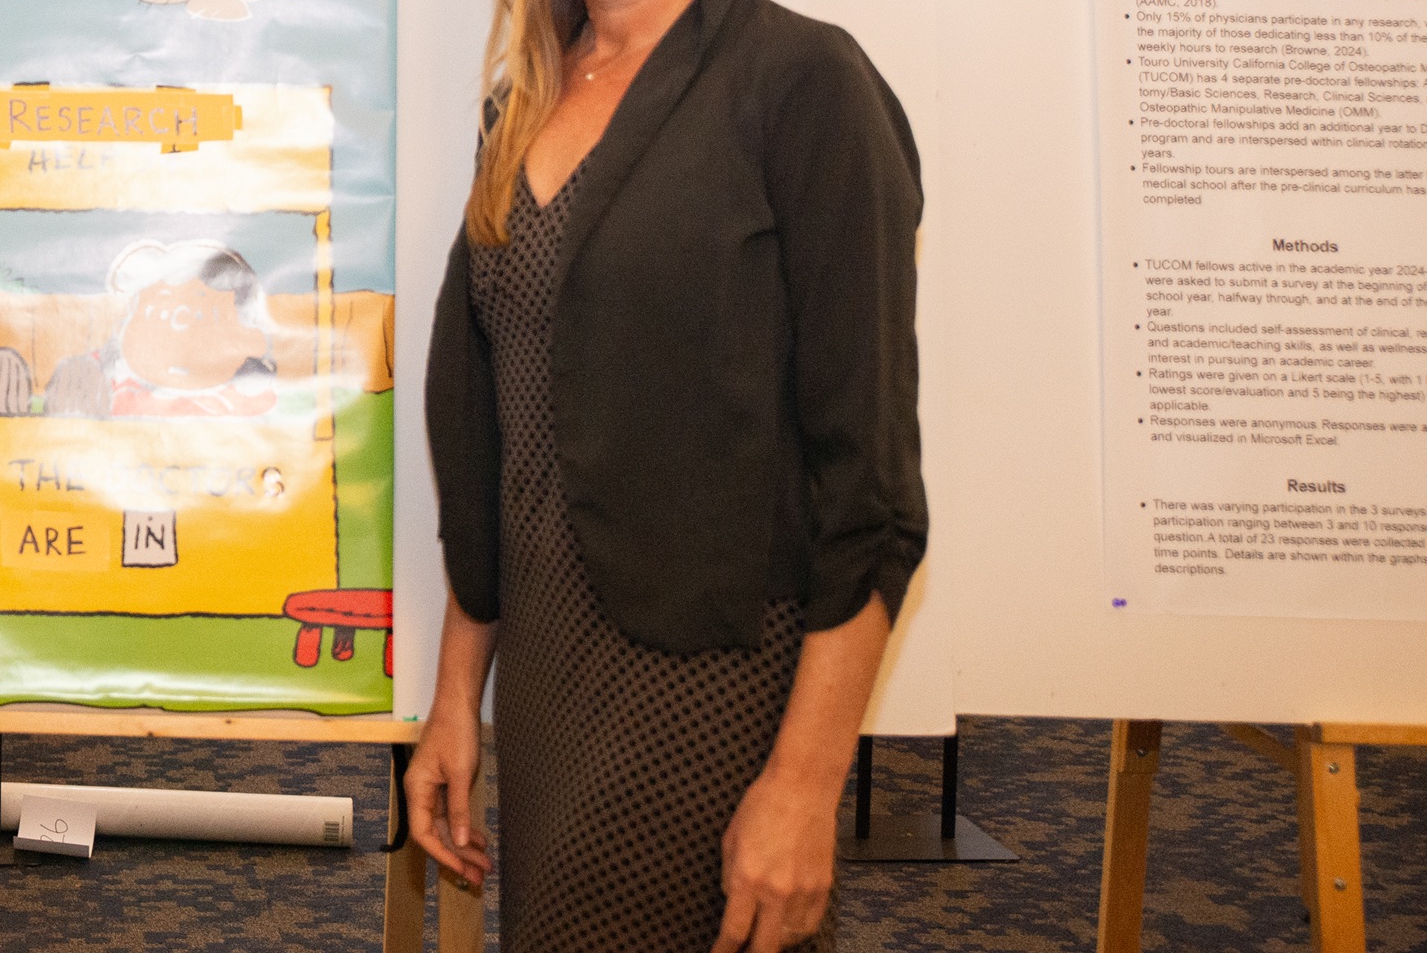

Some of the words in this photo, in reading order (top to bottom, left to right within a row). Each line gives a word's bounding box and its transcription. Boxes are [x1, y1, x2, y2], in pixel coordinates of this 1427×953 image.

[8, 98, 198, 137] RESEARCH
[1272, 239, 1339, 254] Methods
[1145, 260, 1192, 271] TUCOM
[1195, 262, 1234, 272] fellows
[1238, 262, 1272, 273] active
[1275, 263, 1285, 273] in
[1288, 263, 1306, 273] the
[1310, 264, 1364, 274] academic
[1368, 267, 1393, 278] year
[1151, 432, 1172, 442] and
[1176, 433, 1233, 444] visualized
[1237, 434, 1246, 444] in
[1250, 434, 1301, 445] Microsoft
[8, 459, 84, 491] THE
[1287, 479, 1346, 494] Results
[19, 525, 87, 556] ARE
[134, 523, 165, 550] IN
